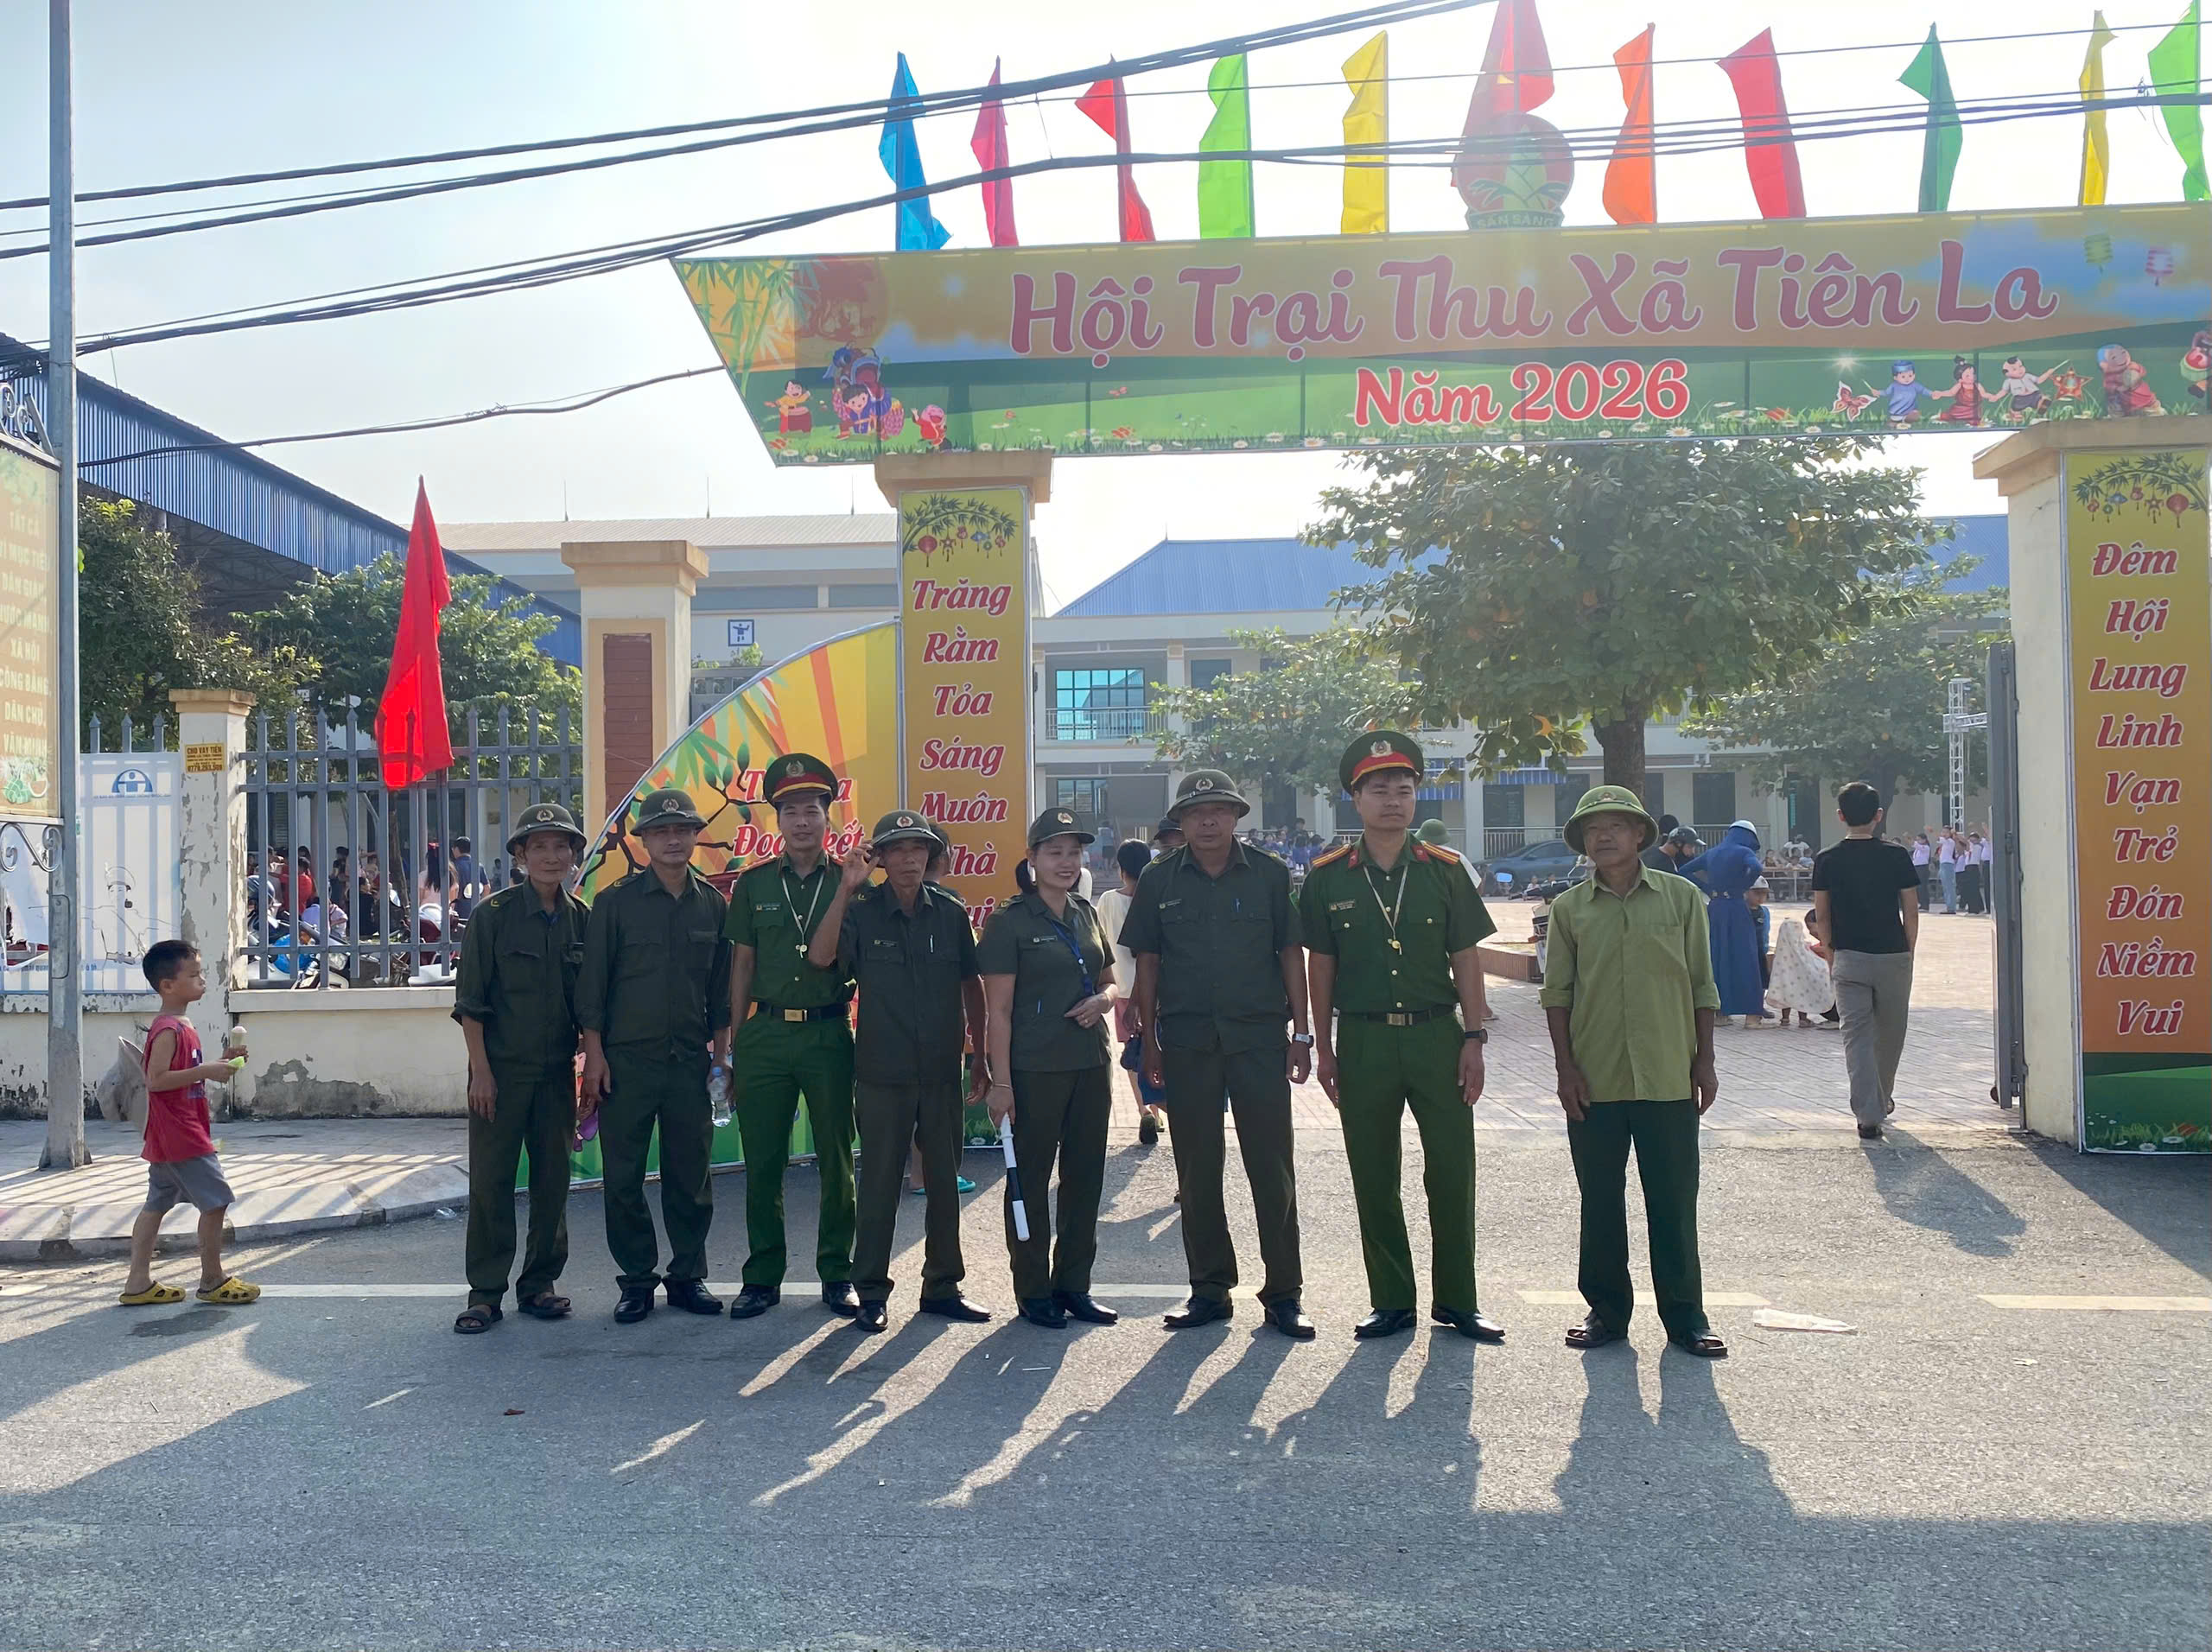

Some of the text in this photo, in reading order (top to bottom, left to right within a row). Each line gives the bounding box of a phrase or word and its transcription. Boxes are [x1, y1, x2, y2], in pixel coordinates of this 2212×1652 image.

[1009, 238, 2061, 369] Hội Trại Thu Xã Tiên La
[1352, 357, 1691, 428] Năm 2026
[2092, 541, 2178, 577] Đêm
[912, 578, 1012, 616] Trăng
[2105, 599, 2170, 642] Hội
[922, 626, 999, 664] Rằm
[2088, 657, 2188, 698] Lung
[933, 683, 994, 718] Tỏa
[2095, 714, 2183, 748] Linh
[918, 735, 1006, 778] Sáng
[920, 791, 1007, 825] Muôn
[2104, 770, 2181, 814] Vạn
[946, 840, 998, 877] hà
[2113, 825, 2178, 863] Trẻ
[961, 896, 995, 930] ui
[2106, 884, 2184, 921] Đón
[2096, 937, 2197, 978] Niềm
[2116, 999, 2184, 1036] Vui
